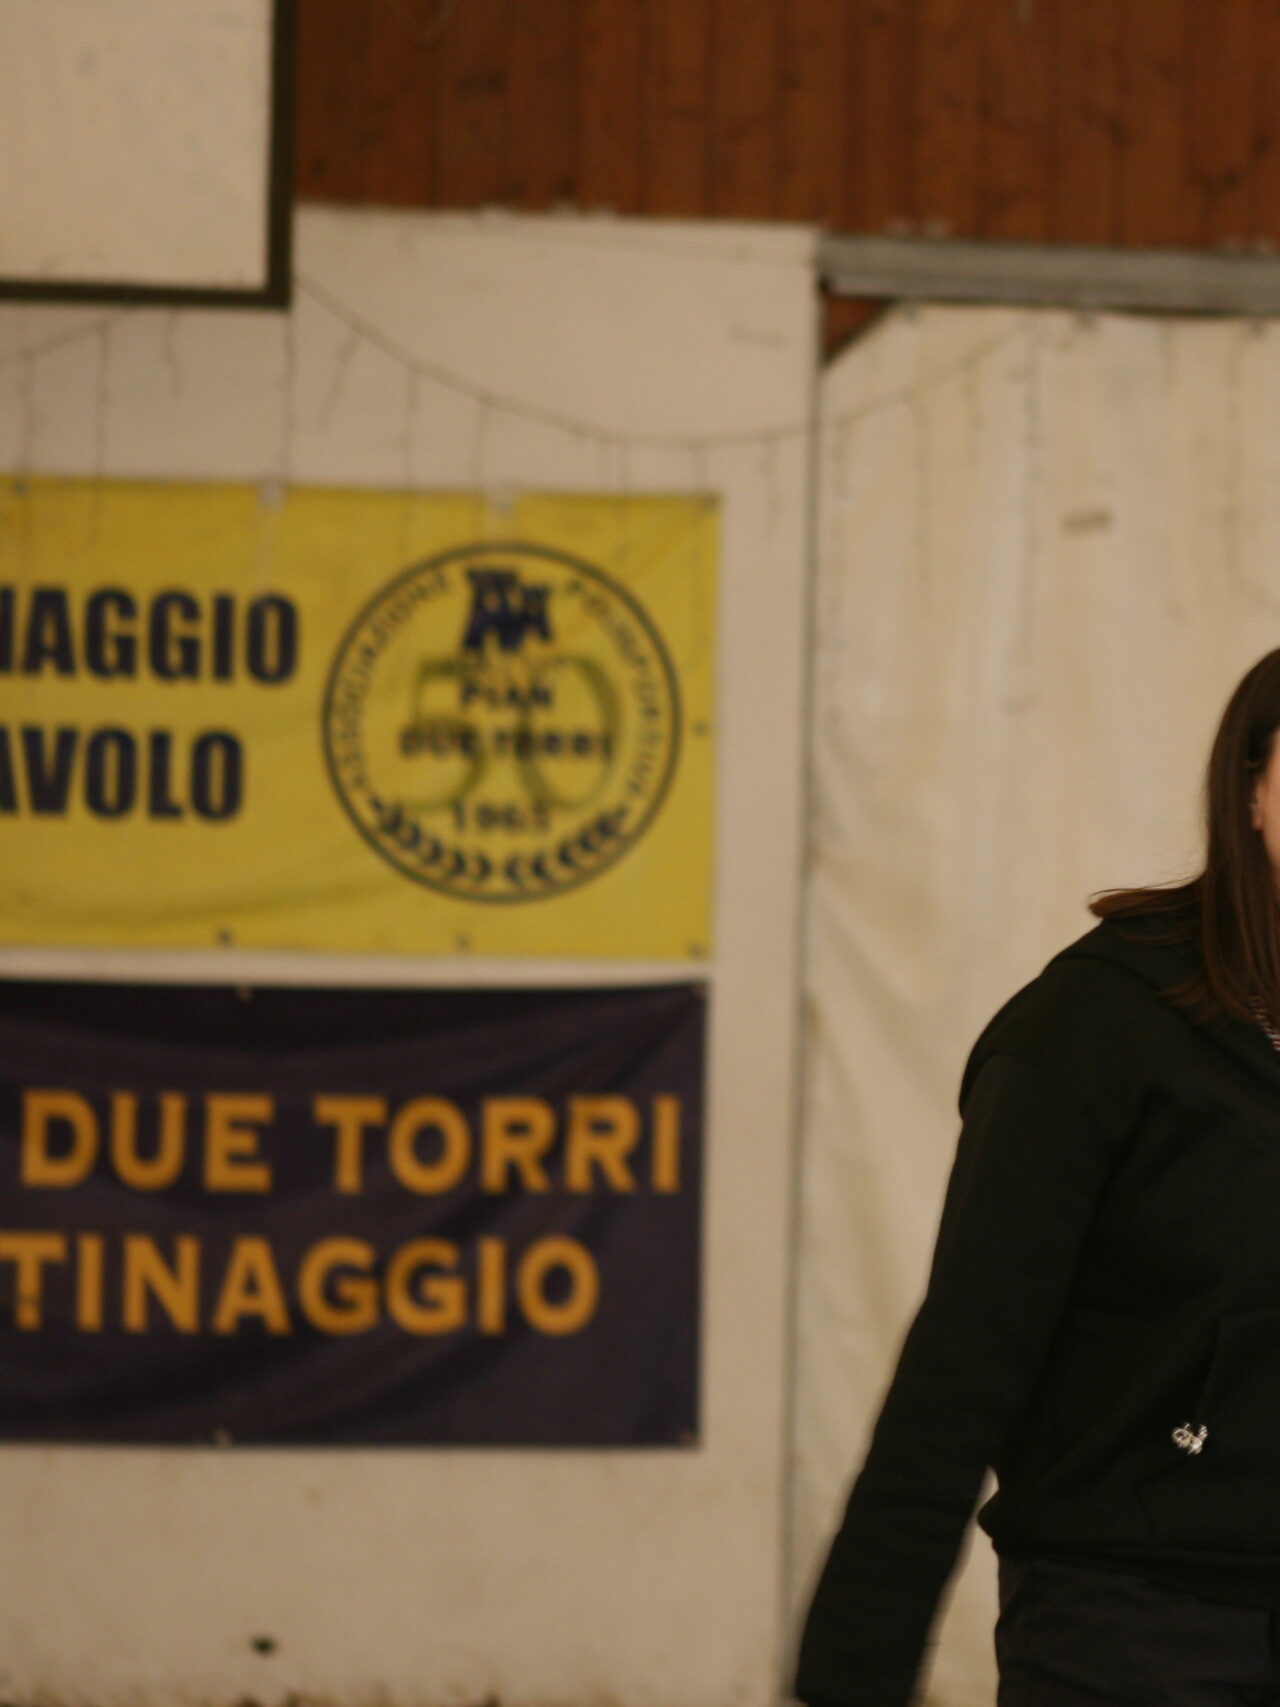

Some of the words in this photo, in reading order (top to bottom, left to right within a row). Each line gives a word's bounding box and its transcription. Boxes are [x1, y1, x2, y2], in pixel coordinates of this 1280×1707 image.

[21, 1090, 273, 1191] DUE
[314, 1094, 681, 1194] TORRI
[0, 1233, 599, 1336] TINAGGIO
